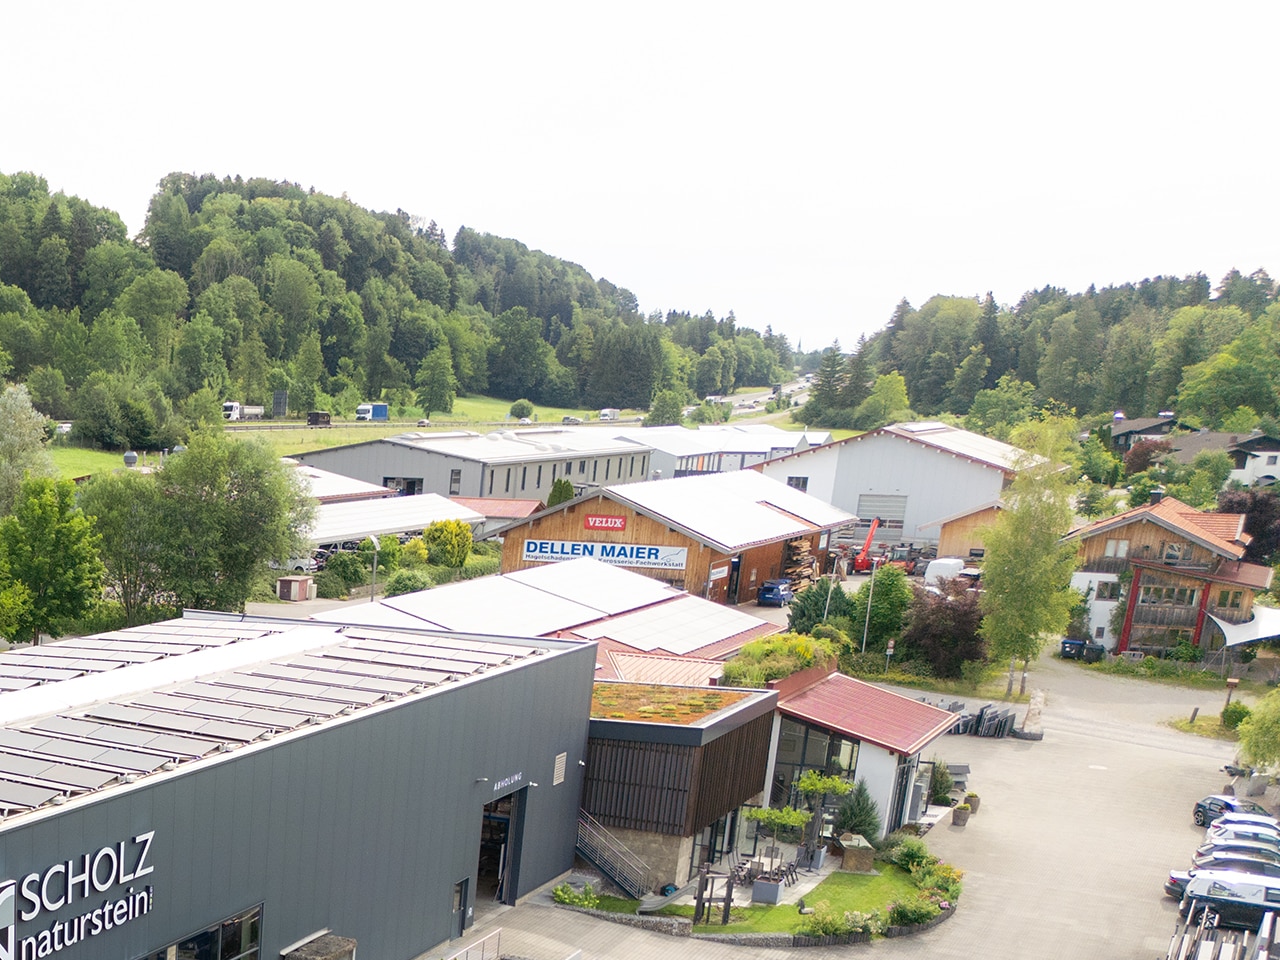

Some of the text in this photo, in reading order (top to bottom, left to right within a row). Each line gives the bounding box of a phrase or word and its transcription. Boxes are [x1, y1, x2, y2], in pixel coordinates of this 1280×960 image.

[588, 517, 623, 528] VELUX
[526, 541, 660, 560] DELLEN MAIER
[21, 831, 156, 922] SCHOLZ
